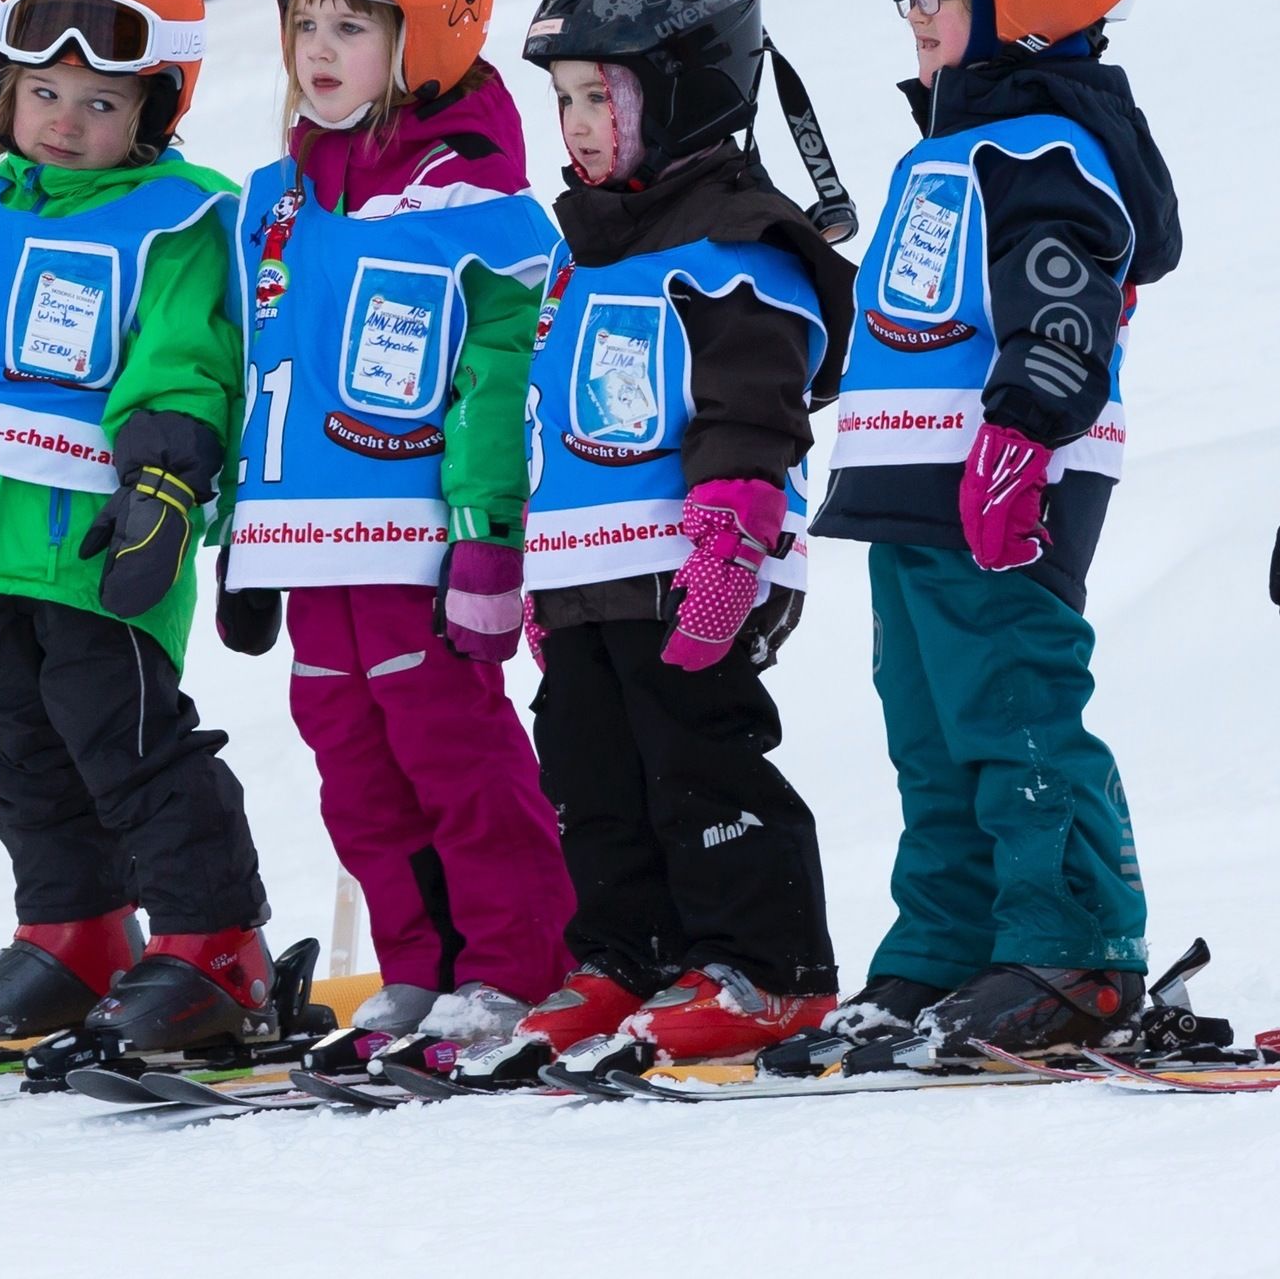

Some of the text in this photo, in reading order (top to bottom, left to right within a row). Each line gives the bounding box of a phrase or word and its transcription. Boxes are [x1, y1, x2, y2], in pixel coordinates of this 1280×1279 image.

[654, 0, 711, 39] uvex
[788, 108, 843, 198] uvex
[328, 416, 384, 450] Wurscht
[388, 437, 401, 451] &
